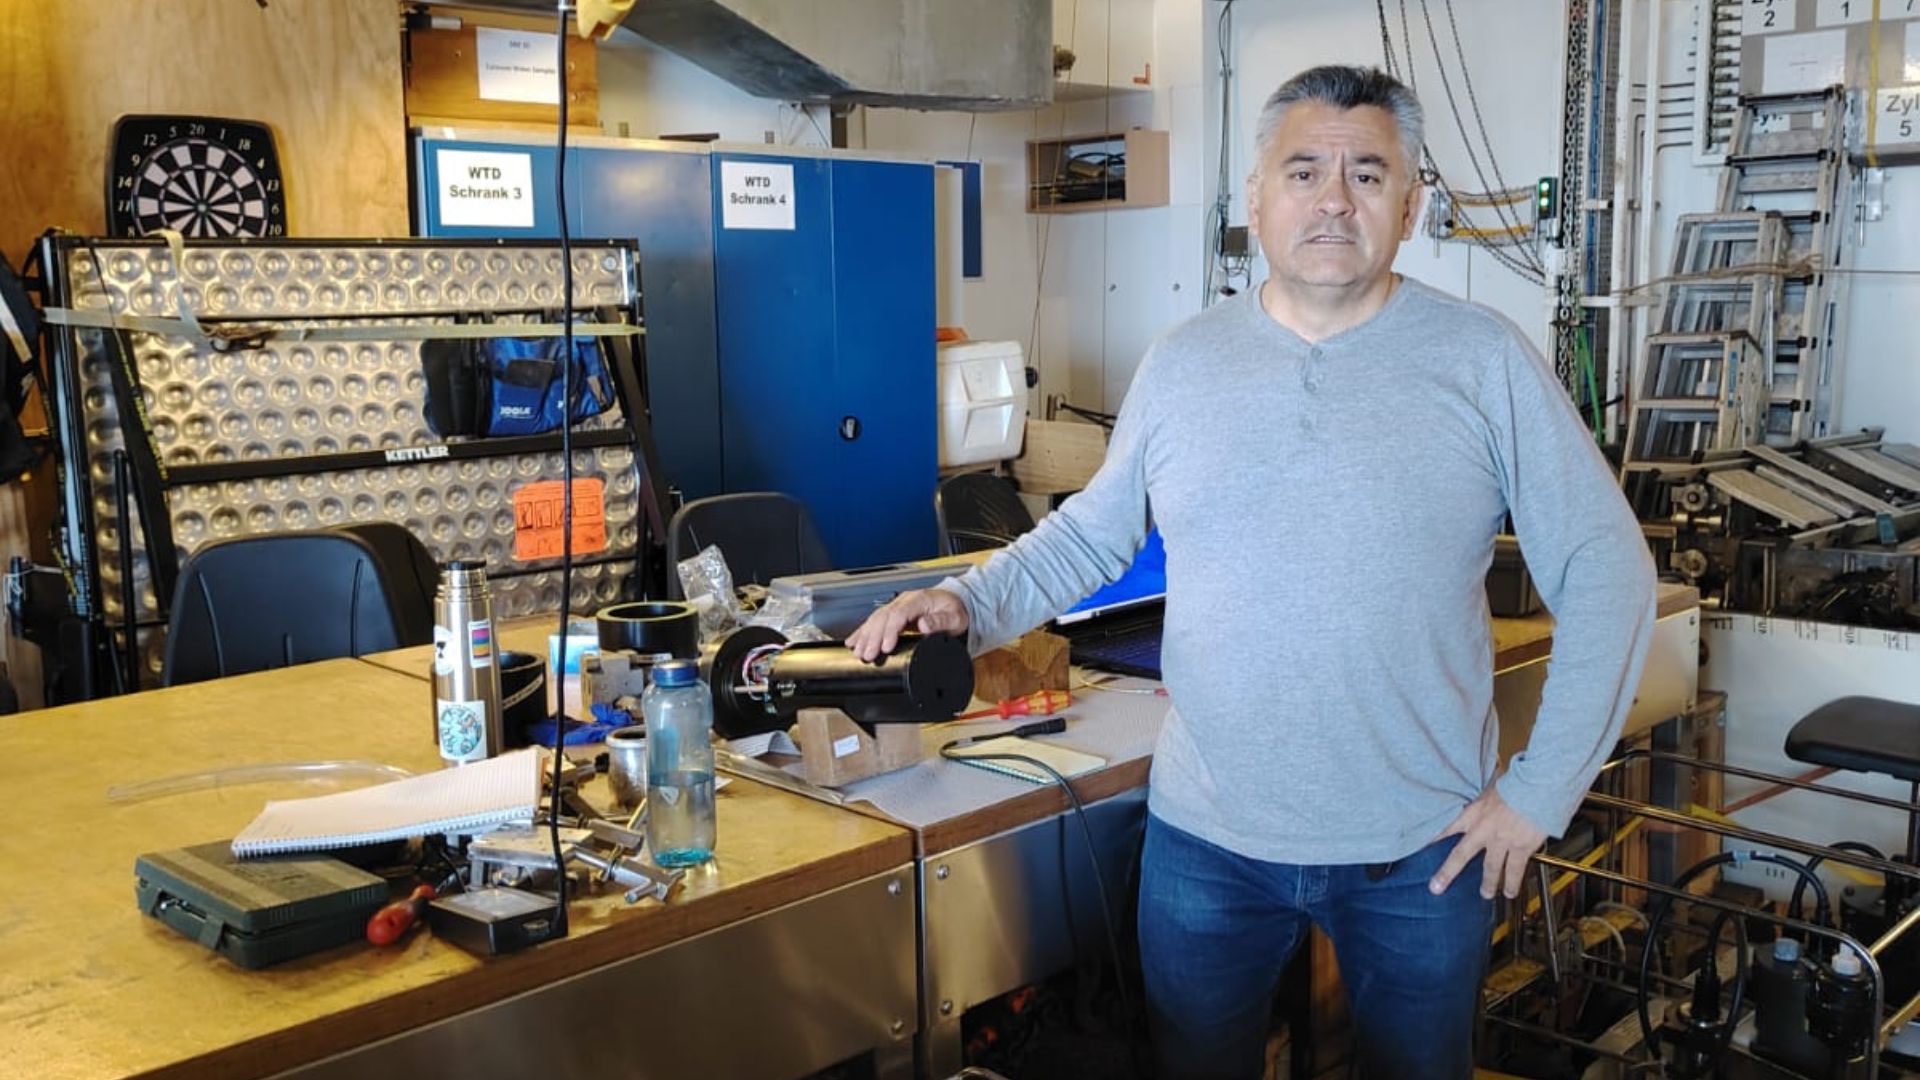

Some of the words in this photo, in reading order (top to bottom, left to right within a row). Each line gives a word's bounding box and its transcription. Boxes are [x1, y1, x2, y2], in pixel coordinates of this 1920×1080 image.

[1763, 10, 1776, 27] 2
[169, 126, 177, 138] 5
[189, 124, 205, 135] 20
[219, 127, 226, 139] 1
[1899, 120, 1912, 137] 5
[143, 133, 157, 146] 12
[238, 138, 251, 150] 18
[131, 154, 140, 165] 9
[256, 158, 265, 169] 4
[468, 166, 502, 180] WTD
[118, 176, 132, 188] 14
[266, 179, 279, 191] 13
[744, 175, 771, 188] WTD
[449, 185, 510, 199] Schrank
[513, 187, 523, 199] 3
[730, 191, 775, 205] Schrank
[778, 193, 787, 205] 4
[118, 200, 131, 212] 11
[271, 203, 280, 214] 6
[268, 224, 282, 235] 10
[385, 445, 449, 462] KETTLER
